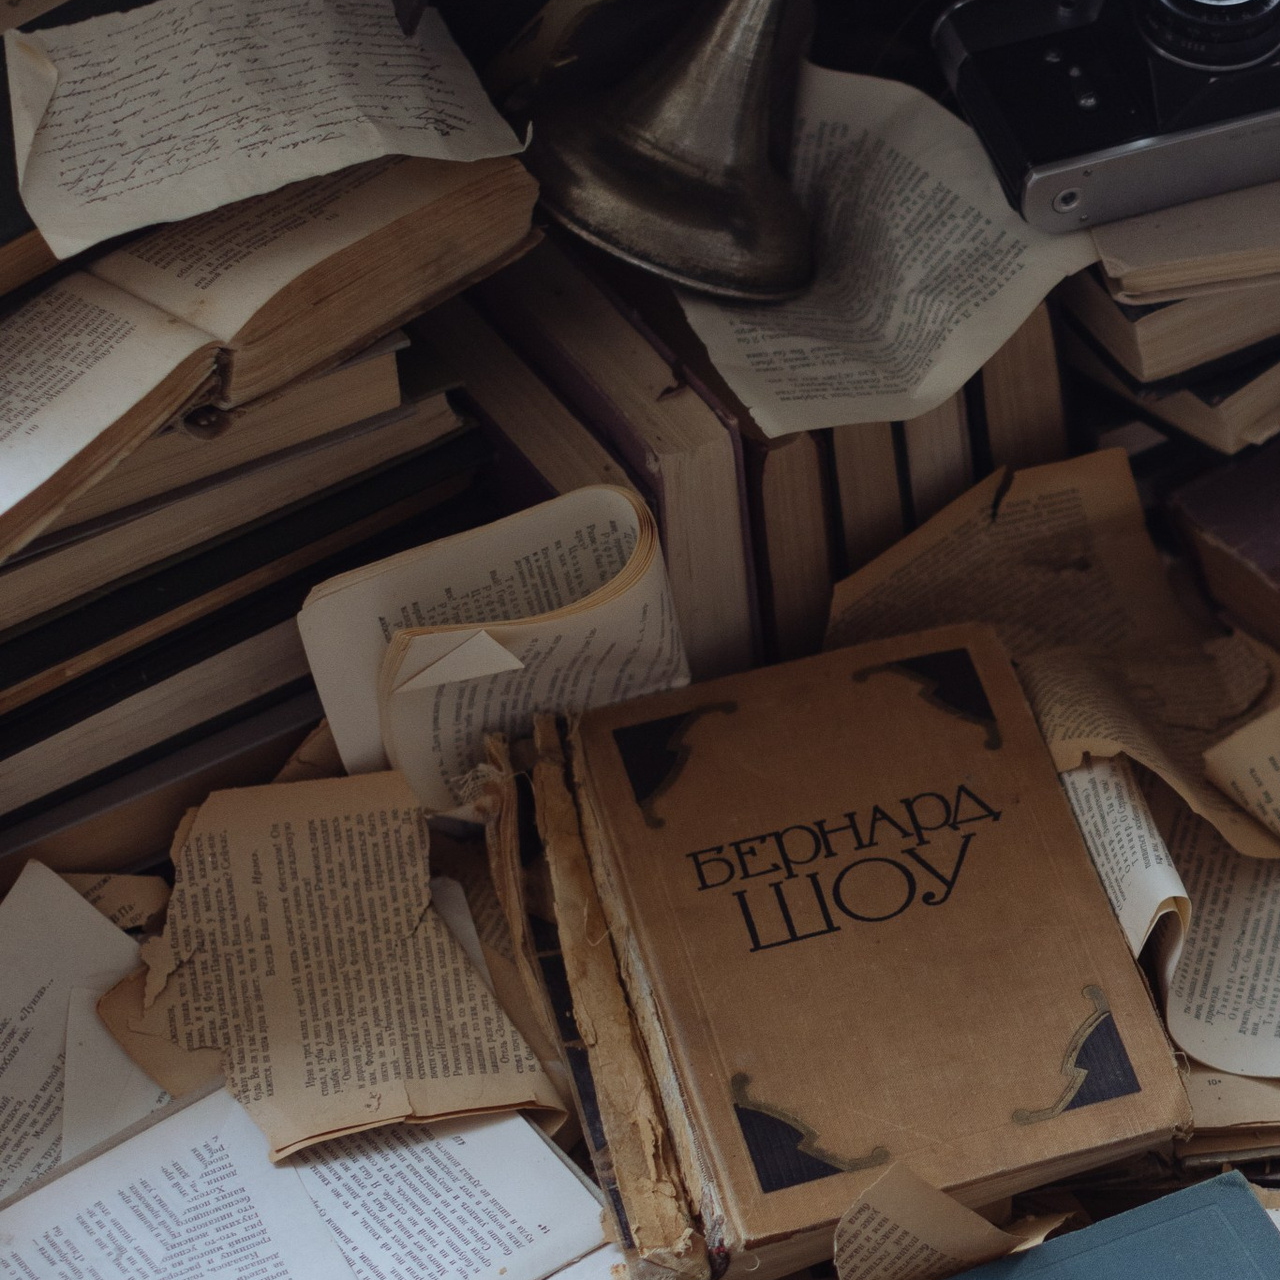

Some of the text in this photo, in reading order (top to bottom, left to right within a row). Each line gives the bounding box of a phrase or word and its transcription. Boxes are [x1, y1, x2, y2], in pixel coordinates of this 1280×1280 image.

[283, 821, 299, 882] загадочную
[686, 783, 1002, 892] БЕРНАРД
[732, 832, 977, 953] ШОУ
[263, 943, 276, 977] Всегда
[26, 1092, 43, 1112] для
[38, 1063, 63, 1093] милой
[10, 1129, 31, 1153] свете
[35, 1092, 57, 1116] знает
[30, 1104, 63, 1140] Мендоса
[329, 1186, 343, 1199] же
[371, 1196, 388, 1213] был
[846, 1201, 871, 1225] была
[392, 1217, 414, 1240] назад
[390, 1251, 406, 1266] пел
[412, 1239, 428, 1253] лет
[425, 1252, 449, 1277] Много
